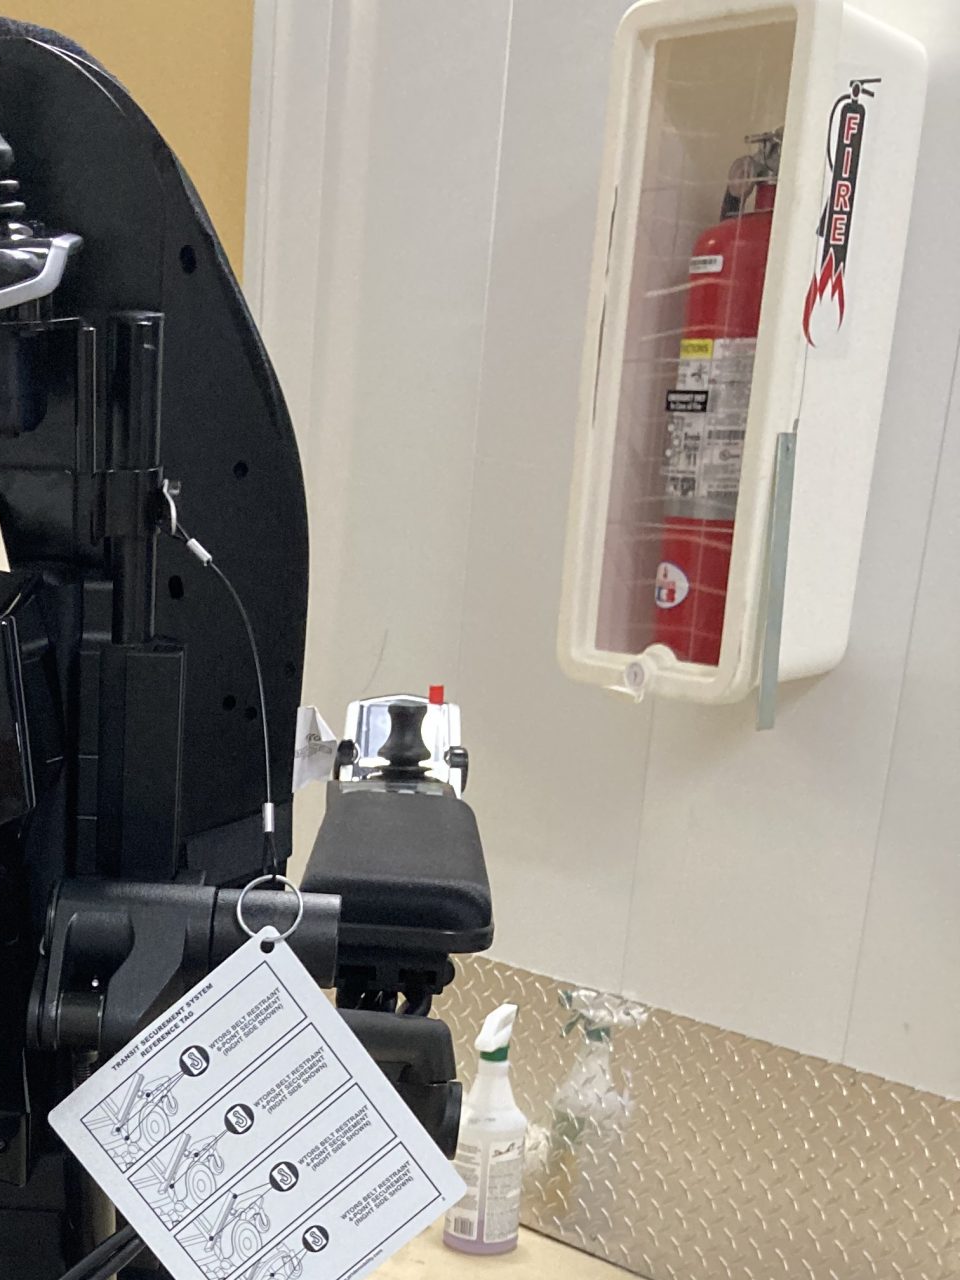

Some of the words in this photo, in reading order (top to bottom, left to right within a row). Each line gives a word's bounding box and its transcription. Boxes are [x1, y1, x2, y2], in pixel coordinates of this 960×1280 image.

[829, 113, 860, 245] FIRE
[110, 1044, 141, 1071] TRANSIT
[139, 1005, 186, 1046] SECUREMENT
[184, 982, 213, 1008] SYSTEM
[230, 1015, 247, 1031] BELT
[246, 987, 281, 1017] RESTRAINT
[239, 995, 281, 1032] SECUREMENT
[139, 1021, 180, 1057] REFERENCE
[179, 1009, 194, 1024] TAG
[242, 1023, 258, 1038] SIDE
[274, 1074, 291, 1089] BELT
[290, 1045, 325, 1076] RESTRAINT
[283, 1054, 325, 1090] SECUREMENT
[286, 1082, 303, 1096] SIDE
[318, 1131, 336, 1147] BELT
[334, 1104, 369, 1134] RESTRAINT
[327, 1112, 369, 1148] SECUREMENT
[331, 1139, 347, 1154] SIDE
[361, 1187, 378, 1202] BELT
[376, 1160, 411, 1190] RESTRAINT
[370, 1167, 411, 1203] SECUREMENT
[373, 1195, 389, 1209] SIDE
